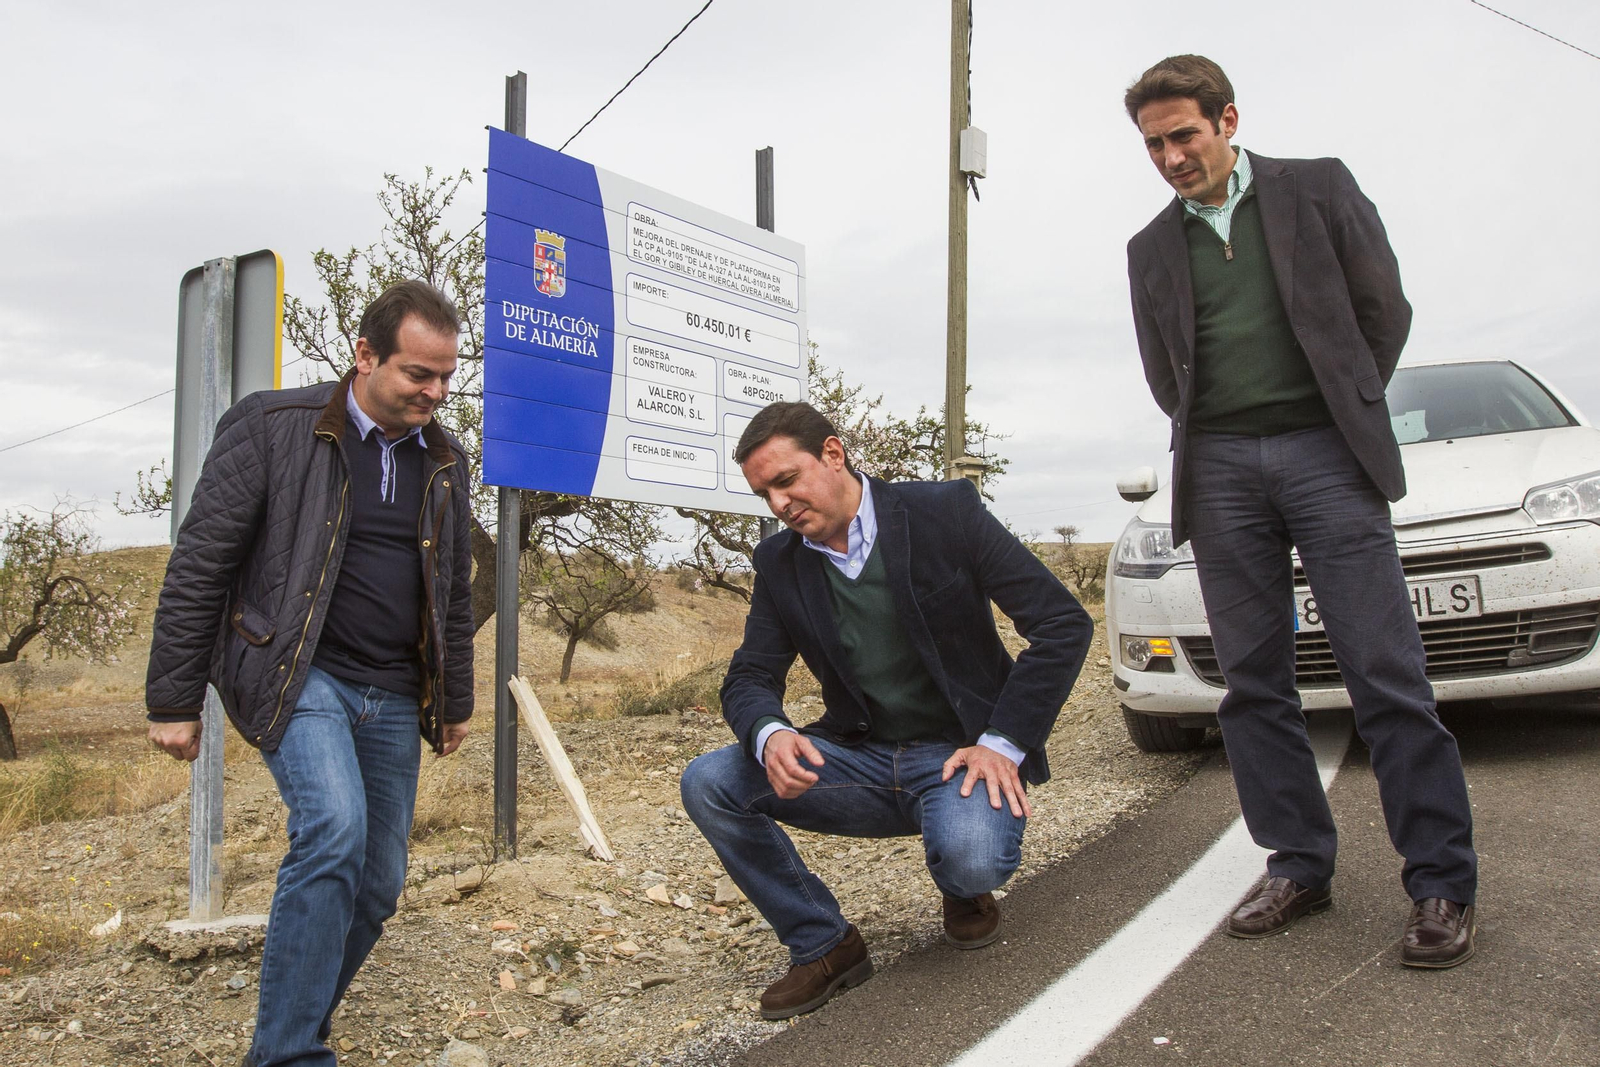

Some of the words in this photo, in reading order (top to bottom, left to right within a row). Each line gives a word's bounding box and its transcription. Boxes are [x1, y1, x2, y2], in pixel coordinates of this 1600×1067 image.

[634, 212, 659, 228] OBRA:
[633, 227, 664, 244] MEJORA
[665, 238, 679, 250] DEL
[680, 243, 713, 261] DRENAJE
[714, 254, 719, 263] Y
[719, 256, 729, 267] DE
[730, 260, 772, 280] PLATAFORMA
[772, 275, 781, 284] EN
[633, 238, 643, 248] LA
[644, 241, 655, 251] CP
[656, 246, 684, 262] AL-9105
[699, 260, 708, 270] LA
[708, 264, 727, 276] A-327
[727, 270, 733, 278] A
[733, 271, 742, 281] LA
[743, 275, 767, 289] AL-8103
[767, 283, 781, 294] POR
[633, 249, 643, 259] EL
[644, 252, 661, 265] GOR
[662, 258, 668, 267] Y
[668, 260, 697, 276] GIBILEY
[697, 269, 707, 280] DE
[740, 284, 762, 298] OVERA
[633, 281, 669, 299] IMPORTE:
[502, 300, 600, 339] DIPUTACIÓN
[686, 312, 741, 340] 60.450,01
[744, 329, 751, 343] €
[505, 321, 527, 341] DE
[530, 328, 599, 358] ALMERÍA
[633, 344, 671, 361] EMPRESA
[632, 356, 698, 379] CONSTRUCTORA:
[728, 368, 748, 380] OBRA
[752, 374, 772, 386] PLAN:
[648, 385, 687, 403] VALERO
[689, 394, 695, 404] Y
[743, 385, 784, 403] 48PG2015
[637, 398, 687, 419] ALARCON,
[689, 408, 706, 421] S.L.
[632, 443, 659, 456] FECHA
[661, 447, 671, 458] DE
[673, 450, 698, 462] INICIO:
